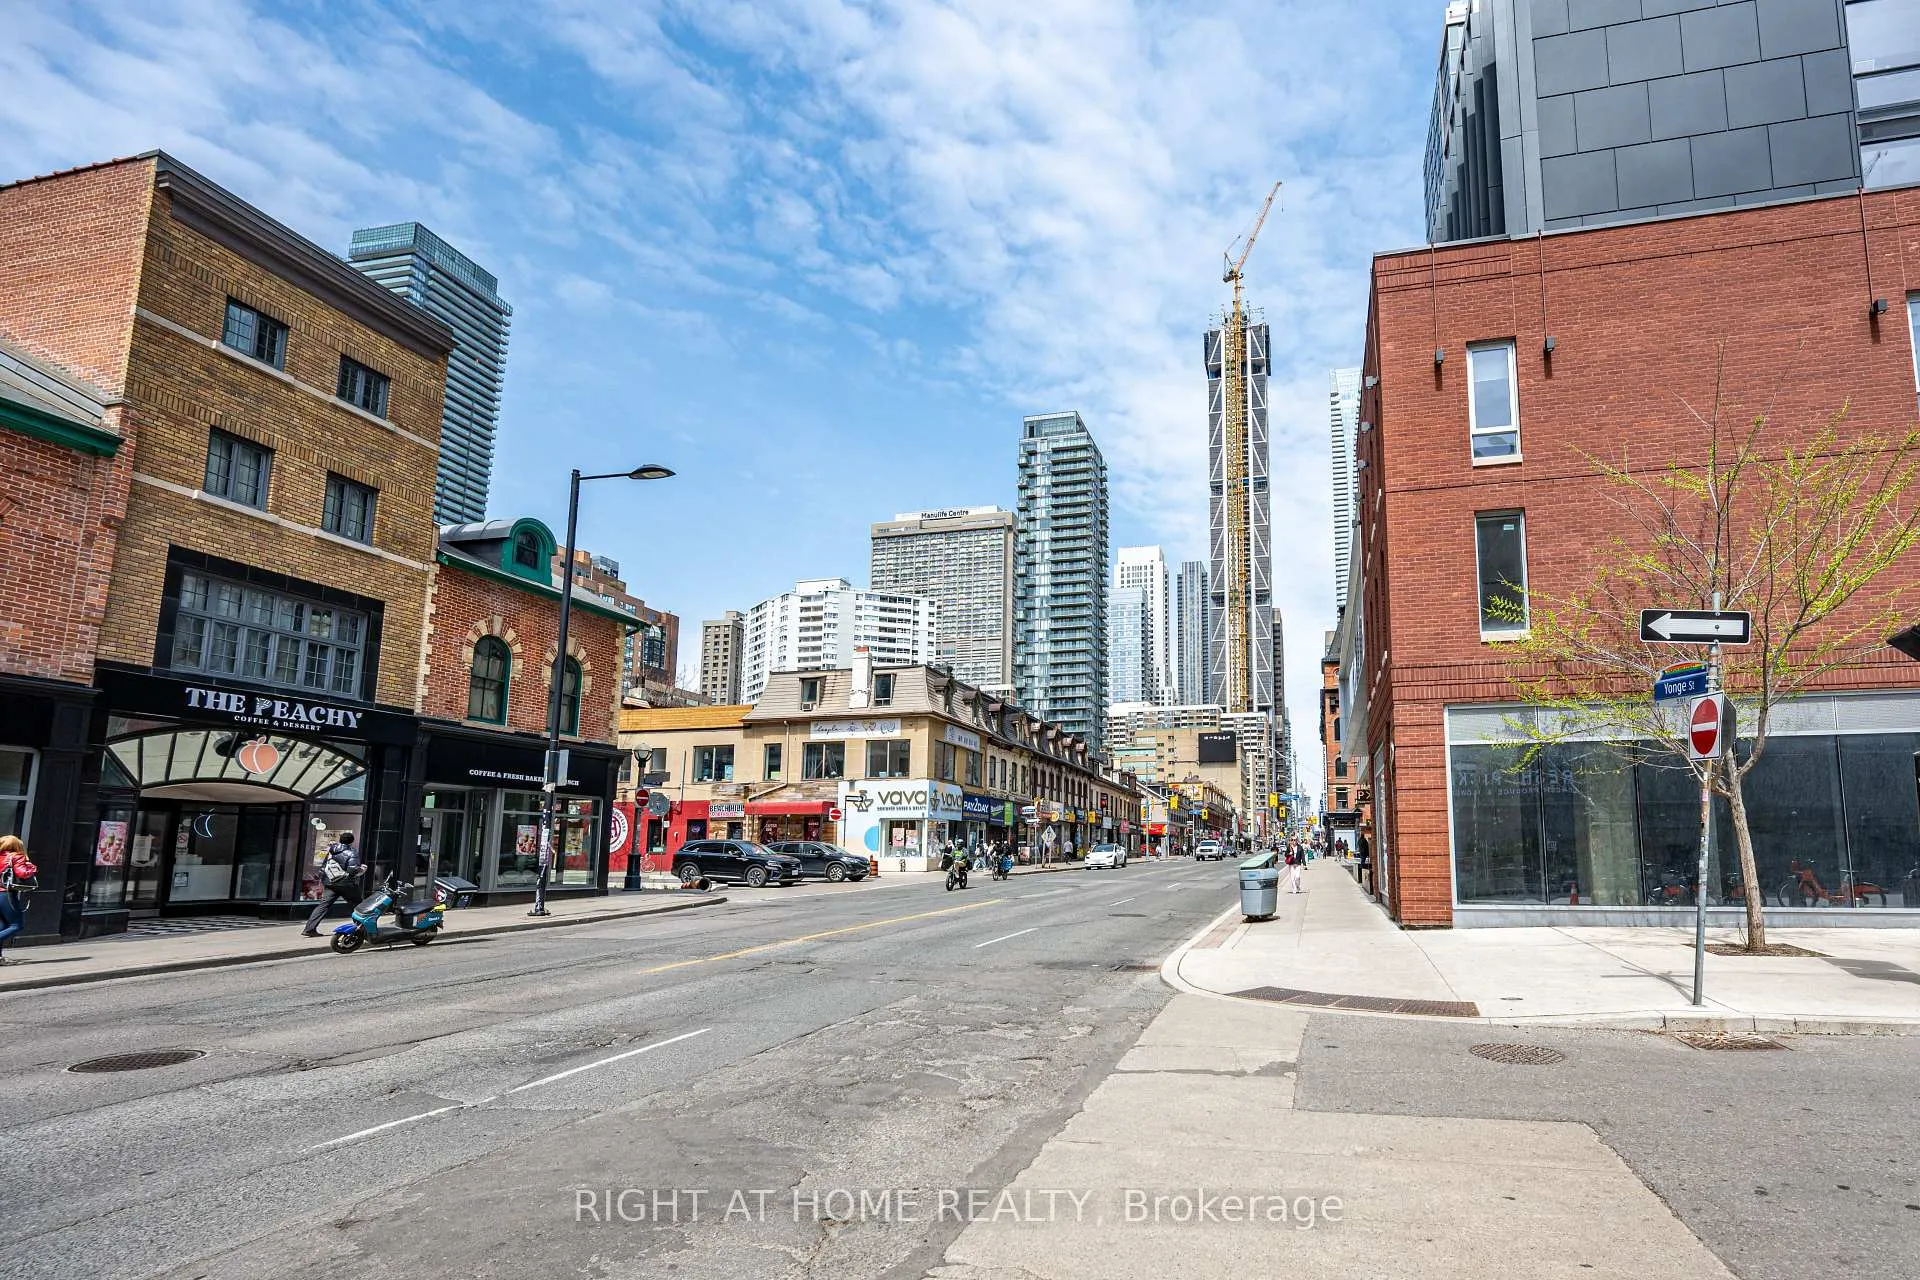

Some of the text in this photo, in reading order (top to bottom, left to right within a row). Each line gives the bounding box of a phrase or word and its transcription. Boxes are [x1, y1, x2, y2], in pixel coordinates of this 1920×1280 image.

[921, 511, 947, 519] Manulife
[1664, 680, 1695, 695] Yonge St
[185, 687, 363, 729] THE PEACHY
[234, 715, 269, 725] COFFEE
[283, 721, 321, 731] DESSERT
[469, 769, 496, 777] COFFEE
[503, 773, 524, 781] FRESH
[963, 797, 989, 813] PAY2DAY
